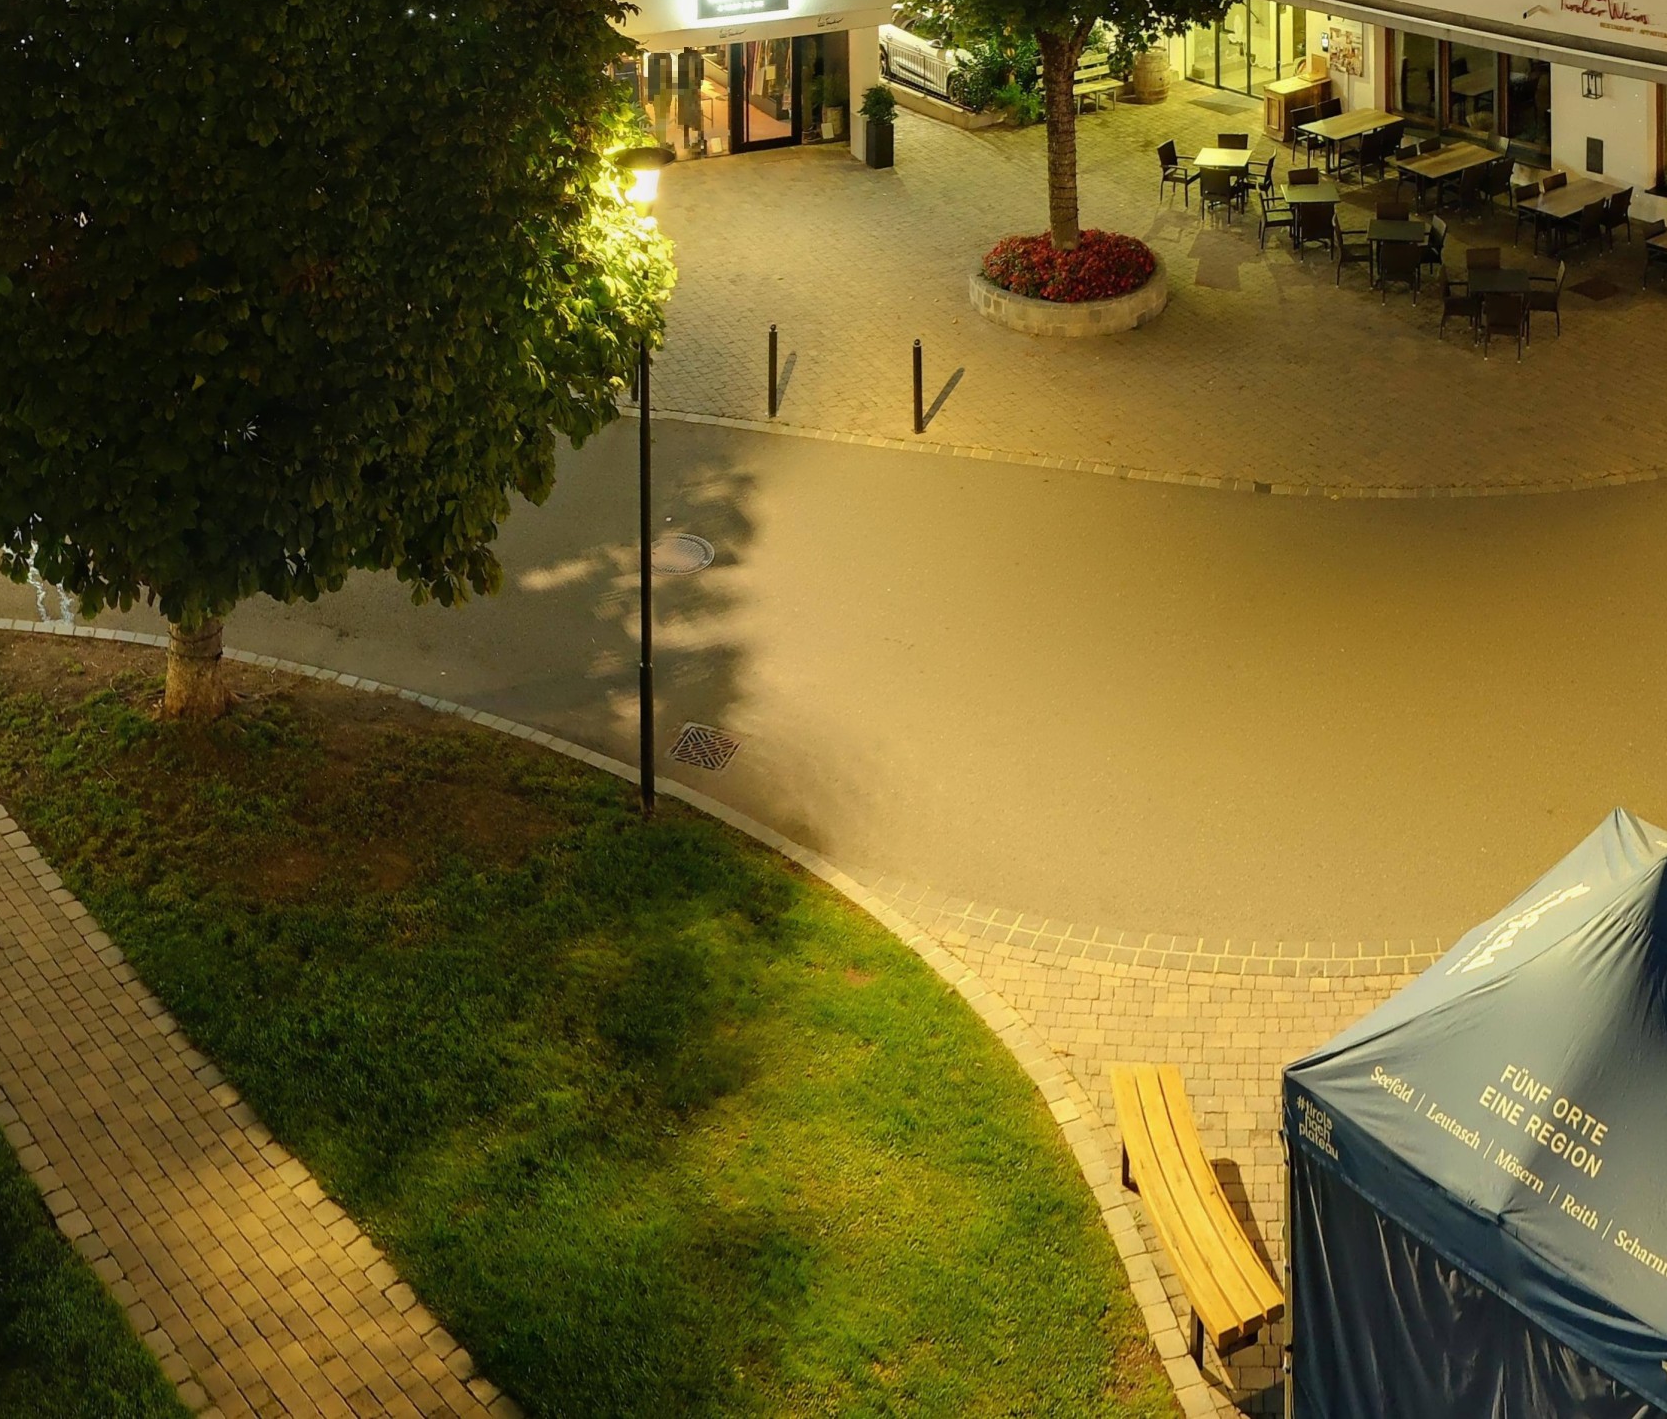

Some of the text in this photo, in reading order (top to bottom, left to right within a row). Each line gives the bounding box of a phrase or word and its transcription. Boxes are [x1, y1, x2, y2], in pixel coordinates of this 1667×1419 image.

[1298, 1122, 1339, 1161] plateau
[1305, 1111, 1331, 1143] hoch
[1479, 1085, 1603, 1179] EINE REGION
[1500, 1064, 1609, 1147] FÜNF ORTE
[1370, 1065, 1415, 1104] Seefeld
[1425, 1102, 1482, 1151] Leutasch
[1494, 1147, 1545, 1195] Mösern
[1560, 1193, 1599, 1231] Reith
